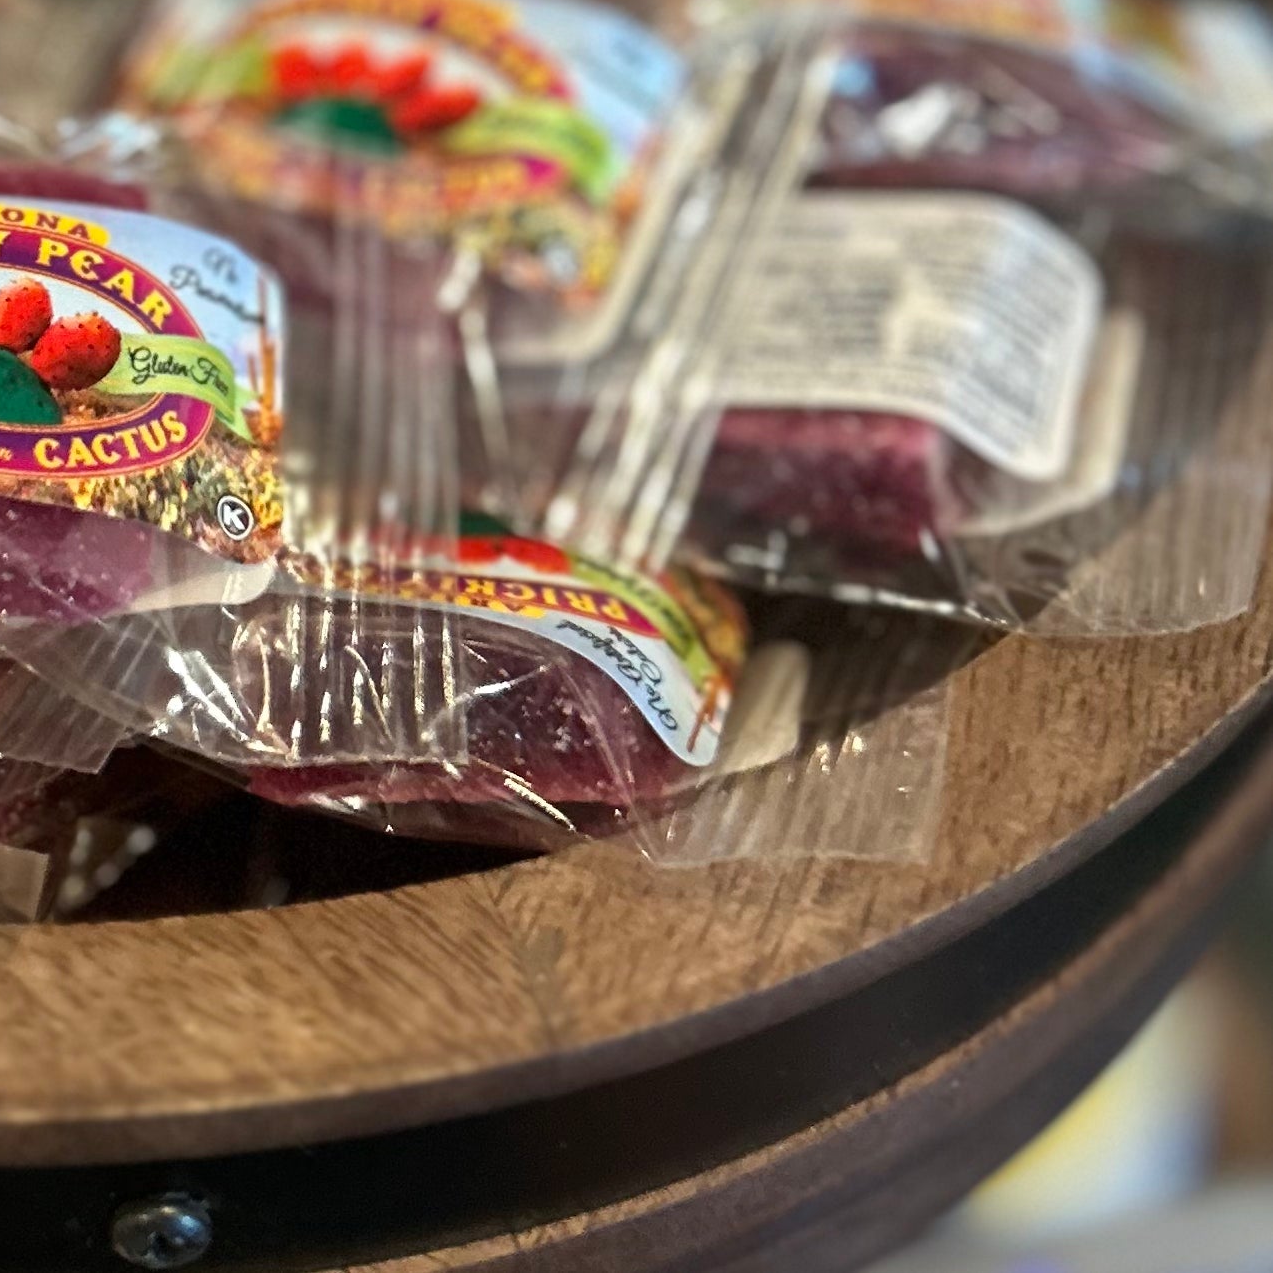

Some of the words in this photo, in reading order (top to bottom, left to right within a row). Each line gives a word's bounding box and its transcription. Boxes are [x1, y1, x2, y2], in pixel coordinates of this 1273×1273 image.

[37, 237, 173, 333] PEAR
[127, 345, 189, 385] Gluten
[33, 410, 188, 469] CACTUS
